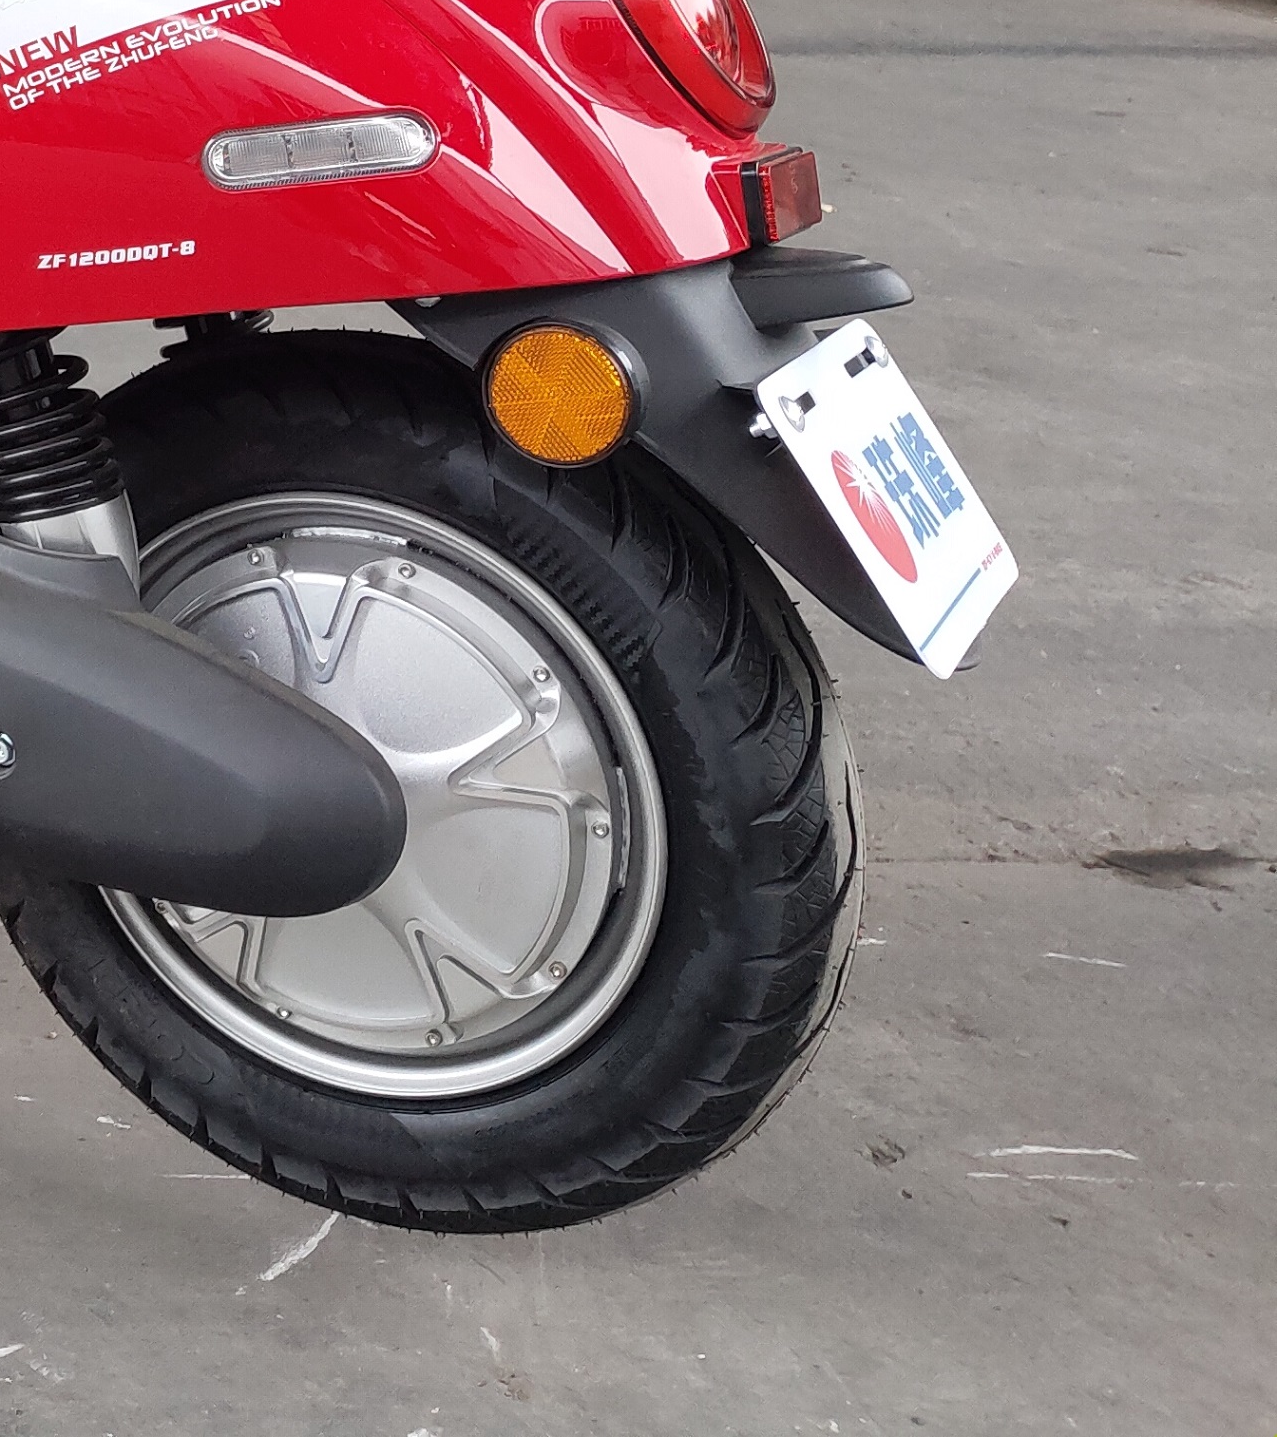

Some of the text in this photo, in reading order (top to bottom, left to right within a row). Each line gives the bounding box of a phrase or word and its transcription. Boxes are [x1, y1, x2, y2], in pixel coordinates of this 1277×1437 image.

[2, 41, 121, 97] MODERN
[9, 88, 44, 110] OF
[46, 67, 101, 94] THE
[37, 240, 195, 269] ZF1200DQT-8
[862, 412, 965, 549] 珠峰
